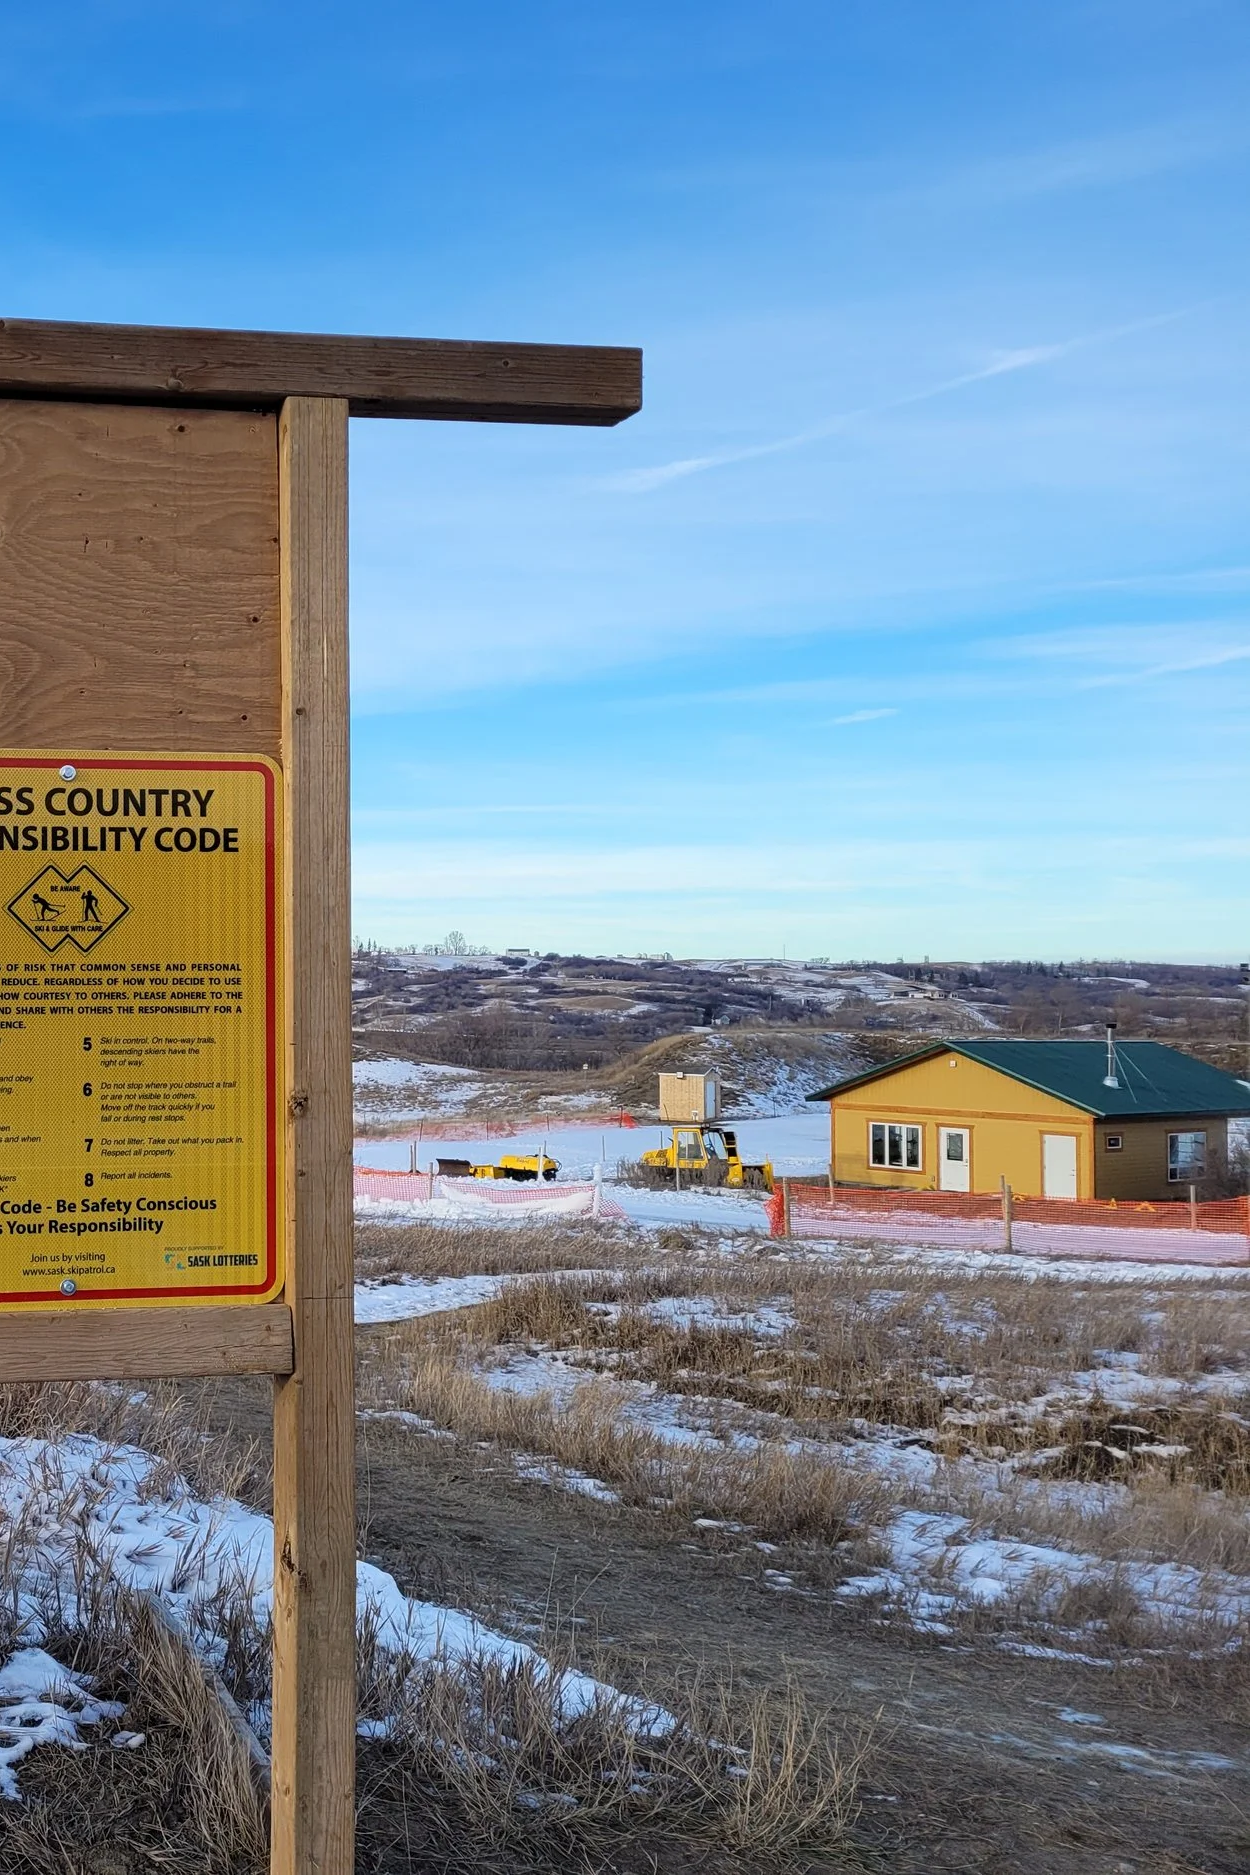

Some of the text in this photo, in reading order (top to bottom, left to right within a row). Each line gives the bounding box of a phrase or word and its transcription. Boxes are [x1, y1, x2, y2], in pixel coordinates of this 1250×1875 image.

[44, 787, 213, 817] COUNTRY
[154, 826, 238, 852] CODE
[6, 963, 18, 971] OF
[24, 963, 45, 971] RISK
[50, 963, 75, 971] THAT
[80, 963, 126, 971] COMMON
[130, 963, 160, 971] SENSE
[165, 963, 186, 971] AND
[191, 963, 240, 971] PERSONAL
[83, 1172, 95, 1188] 8
[0, 1199, 42, 1214] Code
[56, 1199, 76, 1213] Be
[80, 1197, 131, 1215] Safety
[136, 1196, 216, 1211] Conscious
[6, 1220, 44, 1234] Your
[48, 1217, 163, 1236] Responsibility
[30, 1253, 48, 1262] Join
[61, 1252, 72, 1263] by
[74, 1252, 105, 1263] visiting
[187, 1254, 257, 1267] SASK LOTTERIES
[22, 1264, 115, 1276] www.sask.skipatrol.ca
